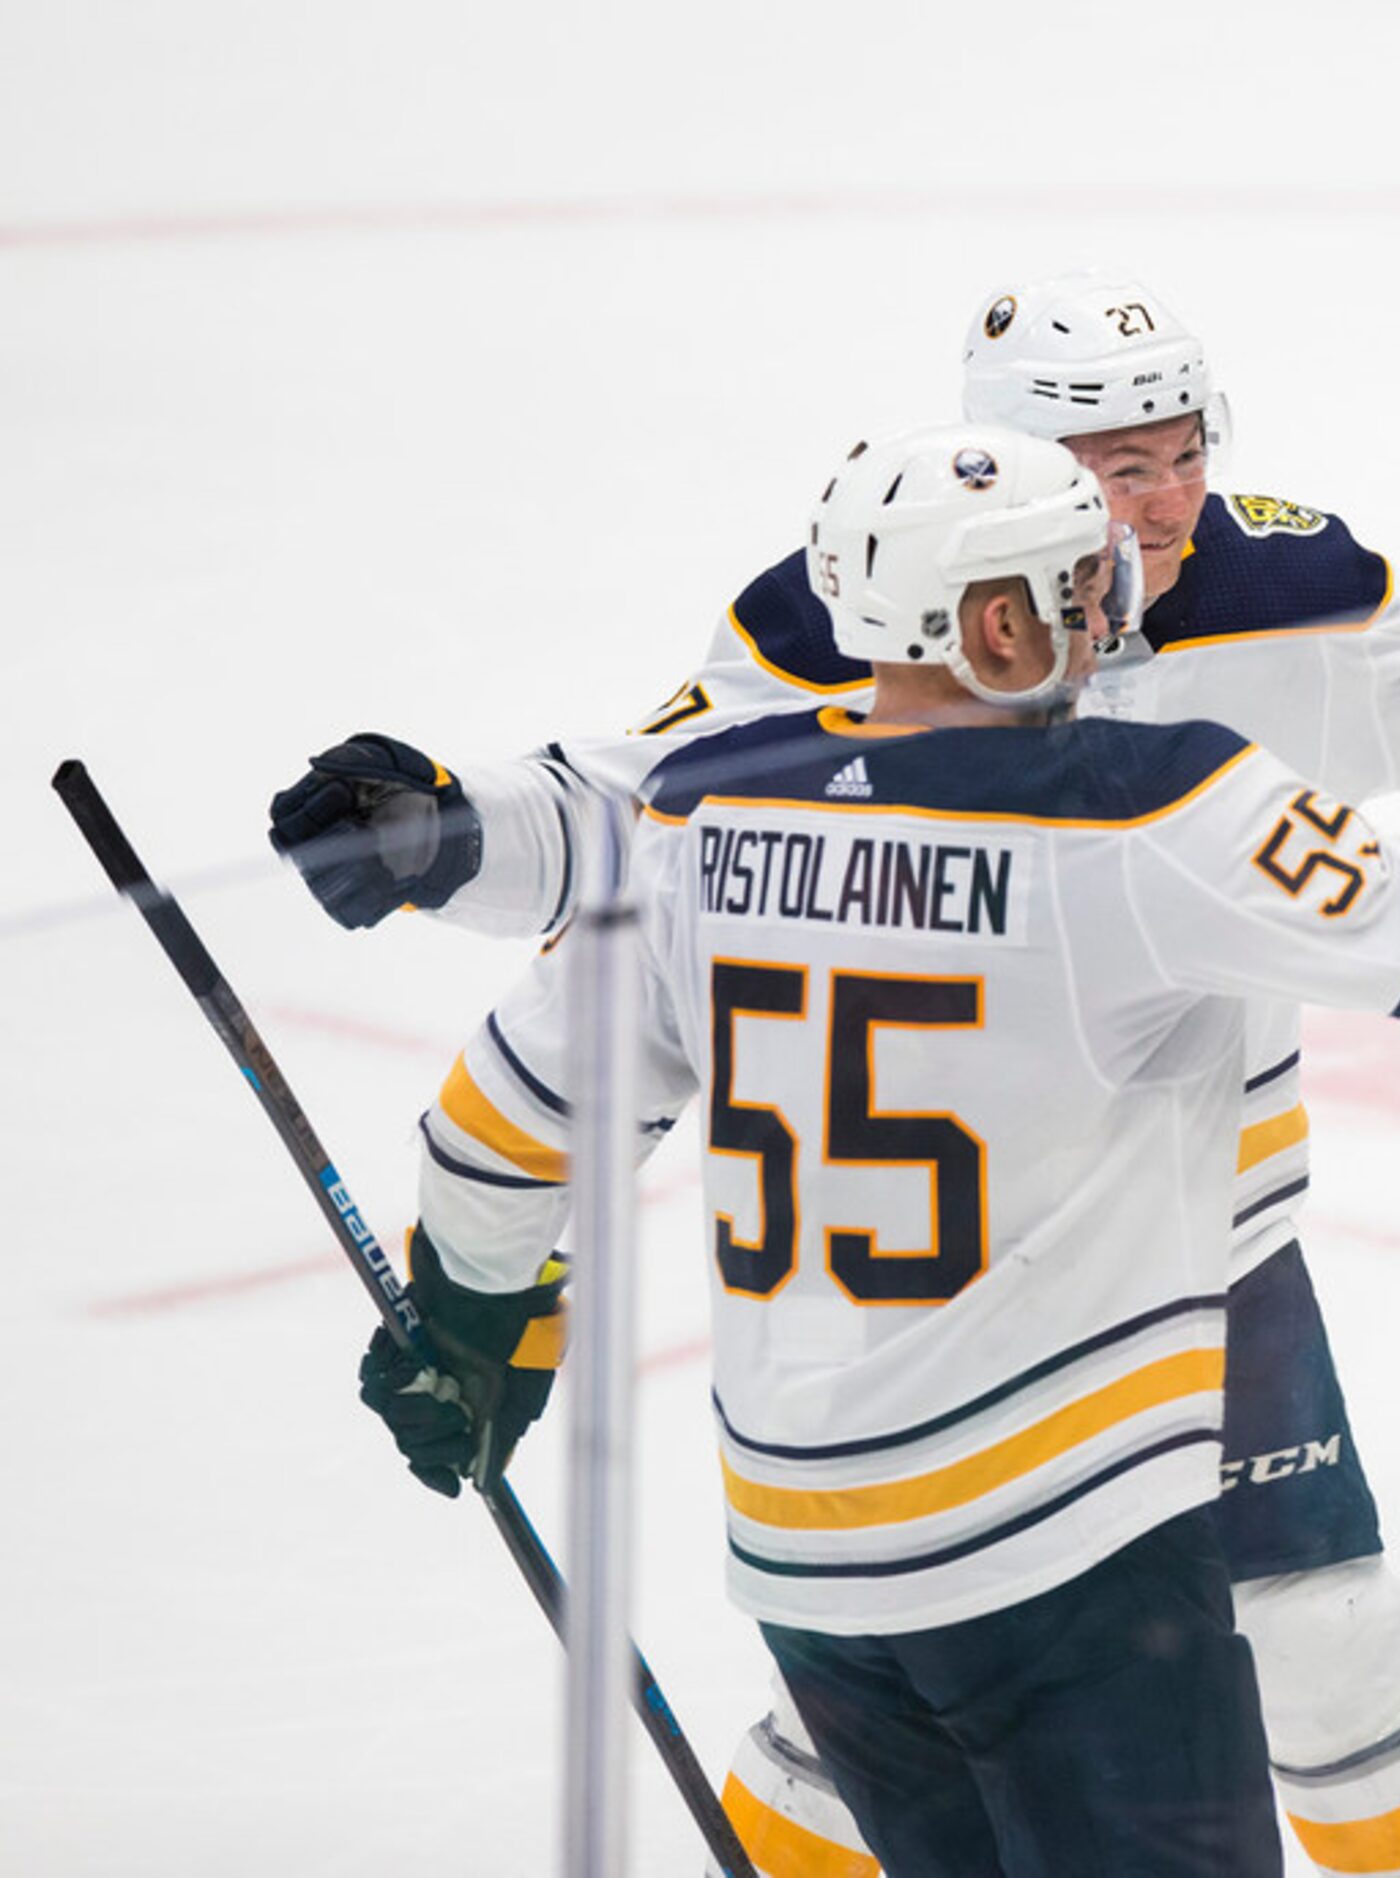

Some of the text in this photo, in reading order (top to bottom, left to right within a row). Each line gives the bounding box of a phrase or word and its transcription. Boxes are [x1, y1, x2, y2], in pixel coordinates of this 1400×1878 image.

[1104, 302, 1156, 338] 27
[825, 783, 874, 797] adidas
[700, 826, 1012, 936] RISTOLAINEN
[707, 954, 990, 1308] 55
